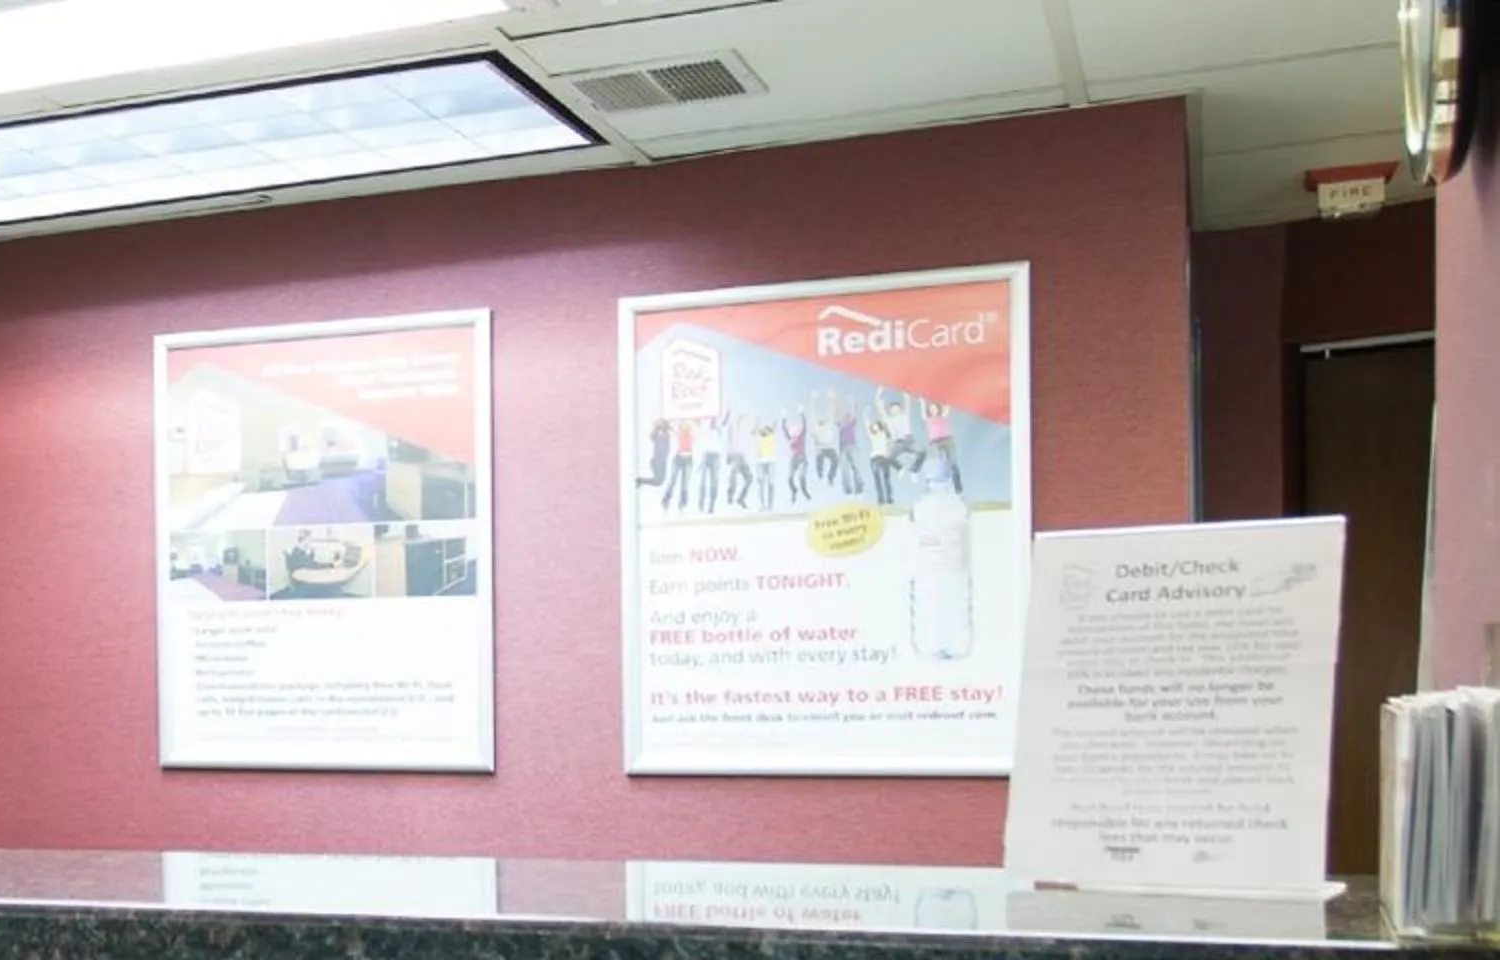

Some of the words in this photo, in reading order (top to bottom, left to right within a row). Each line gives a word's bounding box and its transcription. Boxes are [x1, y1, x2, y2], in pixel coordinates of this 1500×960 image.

[1329, 186, 1373, 200] FIRE
[1115, 558, 1240, 579] Debit/Check
[650, 579, 688, 595] Earn
[694, 577, 749, 596] points
[1105, 588, 1152, 603] Card
[1156, 583, 1247, 602] Advisory
[650, 610, 685, 625] And
[691, 609, 740, 627] enjoy
[746, 611, 758, 623] a
[650, 630, 695, 646] FREE
[702, 628, 763, 645] bottle
[769, 626, 791, 642] of
[797, 626, 858, 641] water
[650, 651, 702, 668] today,
[708, 650, 744, 665] and
[749, 648, 790, 664] with
[796, 649, 846, 665] every
[851, 648, 897, 665] stay!
[651, 691, 679, 705] It's
[685, 689, 718, 704] the
[724, 689, 791, 704] fastest
[798, 690, 840, 706] way
[846, 688, 869, 703] to
[875, 690, 887, 702] a
[893, 686, 944, 702] FREE
[950, 684, 1004, 704] stay!
